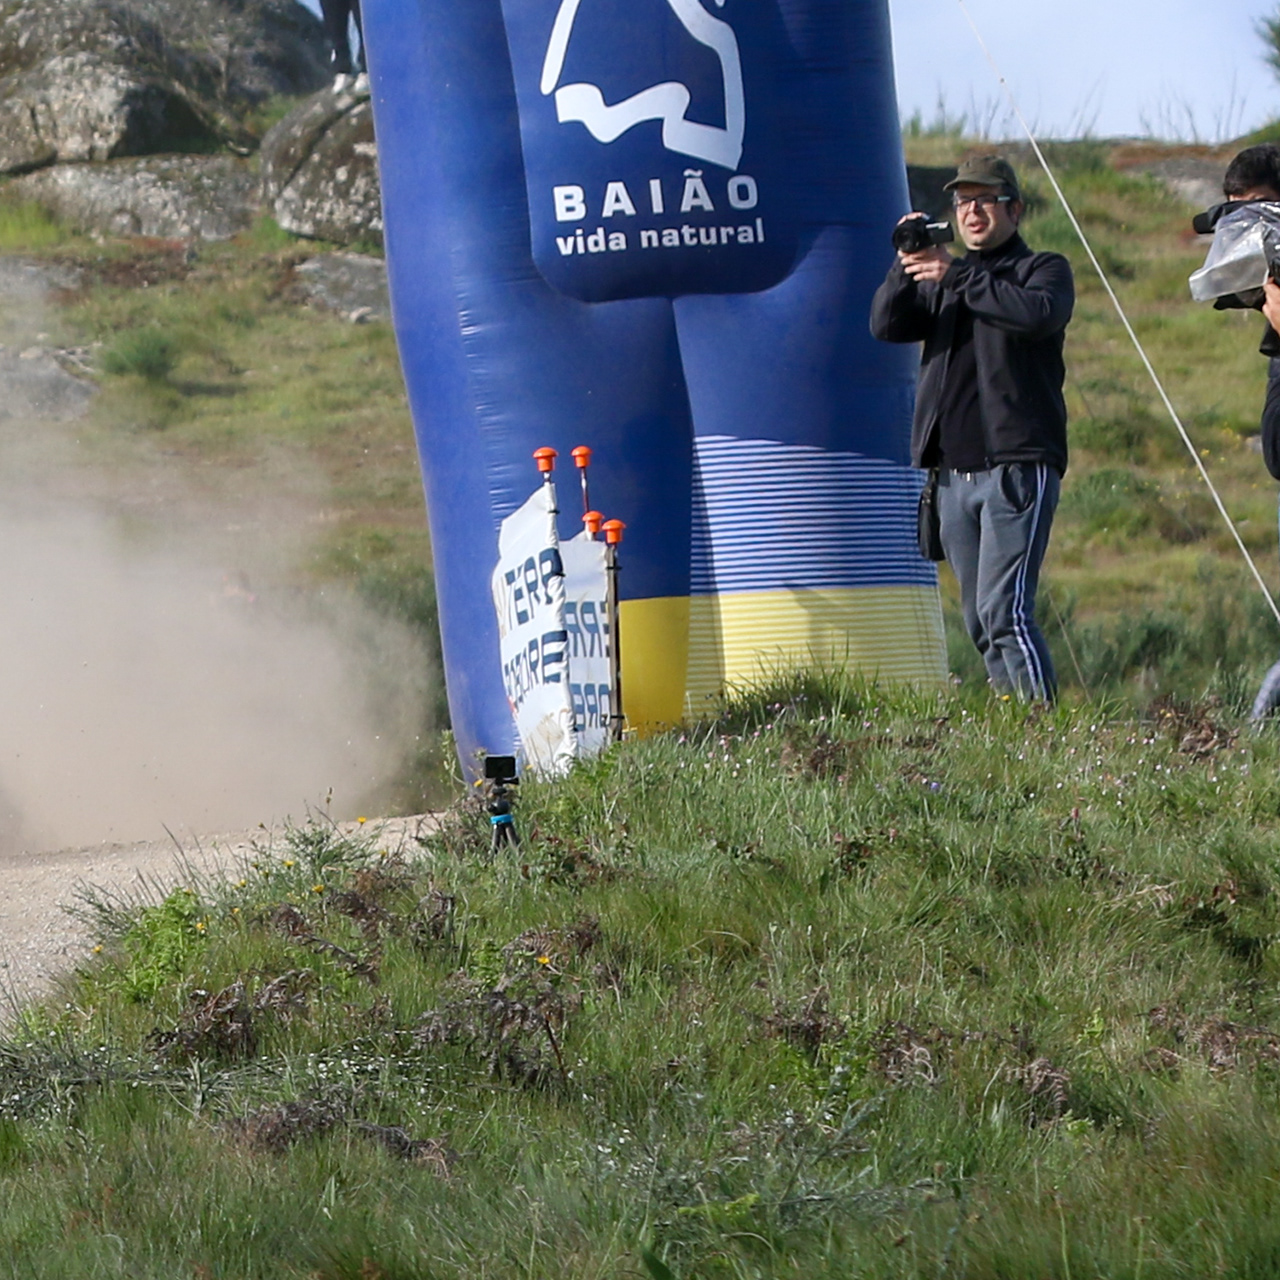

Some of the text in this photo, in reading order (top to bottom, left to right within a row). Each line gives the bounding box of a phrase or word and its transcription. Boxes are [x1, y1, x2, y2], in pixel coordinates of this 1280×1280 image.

[553, 169, 758, 222] BAIÃO
[556, 218, 765, 256] vida natural
